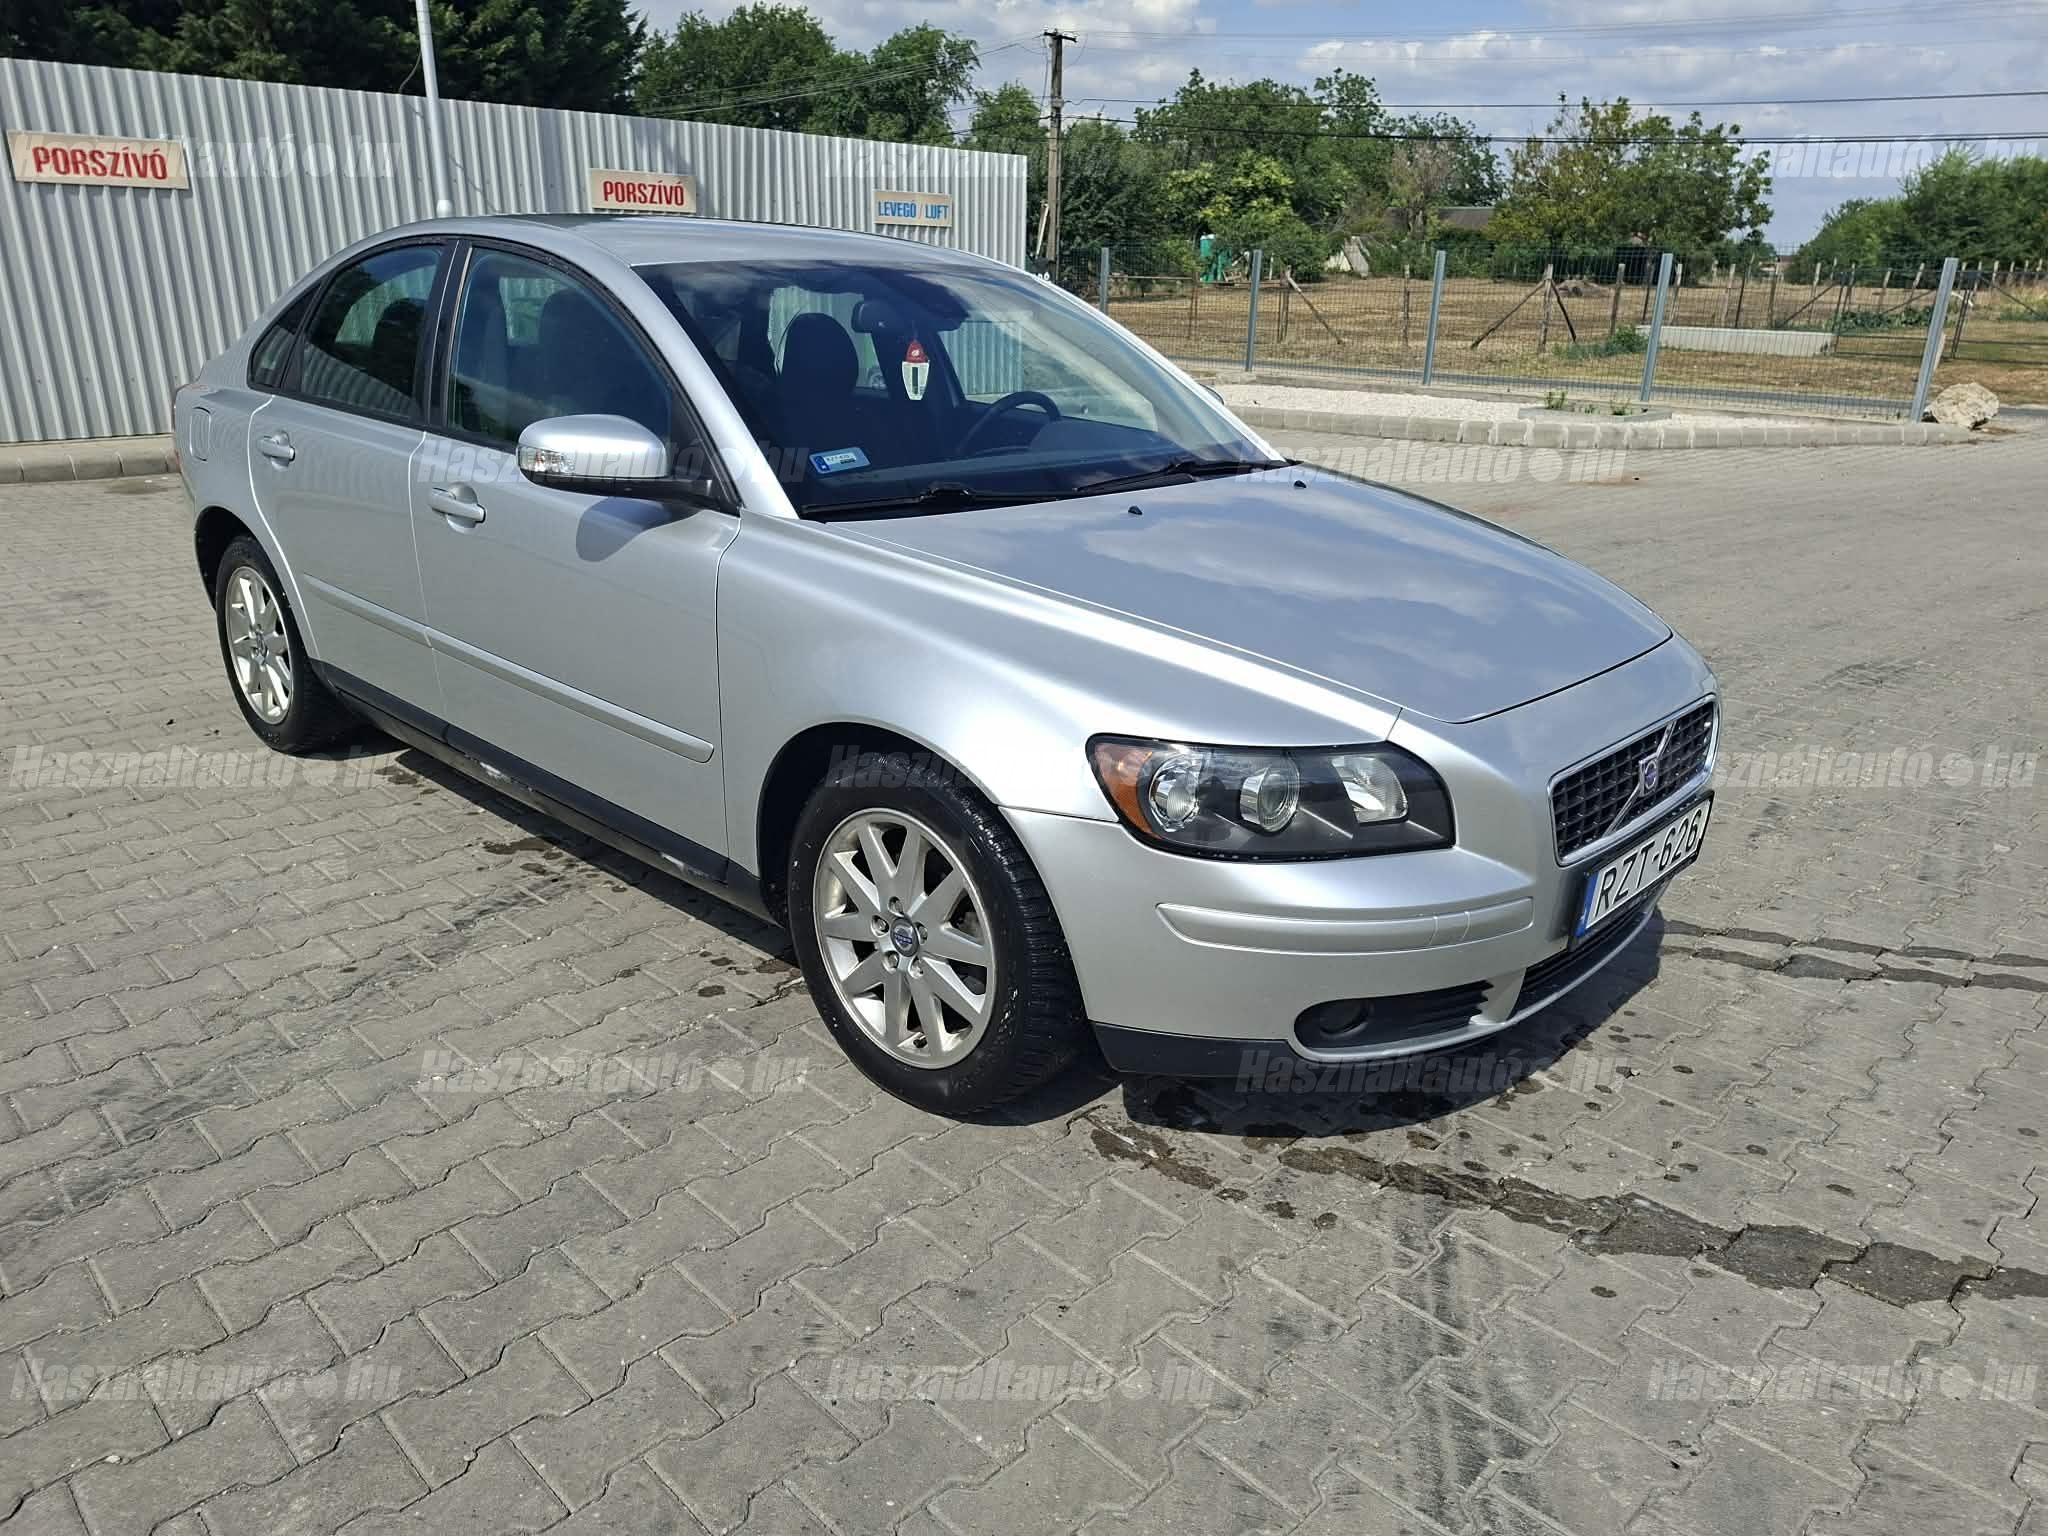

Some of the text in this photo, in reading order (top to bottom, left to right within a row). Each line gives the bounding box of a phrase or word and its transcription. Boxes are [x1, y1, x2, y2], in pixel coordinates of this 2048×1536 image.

[32, 146, 169, 180] PORSZÍVÓ
[603, 180, 685, 206] PORSZÍVÓ
[925, 204, 949, 219] LUFT
[1595, 809, 1702, 917] RZT-626
